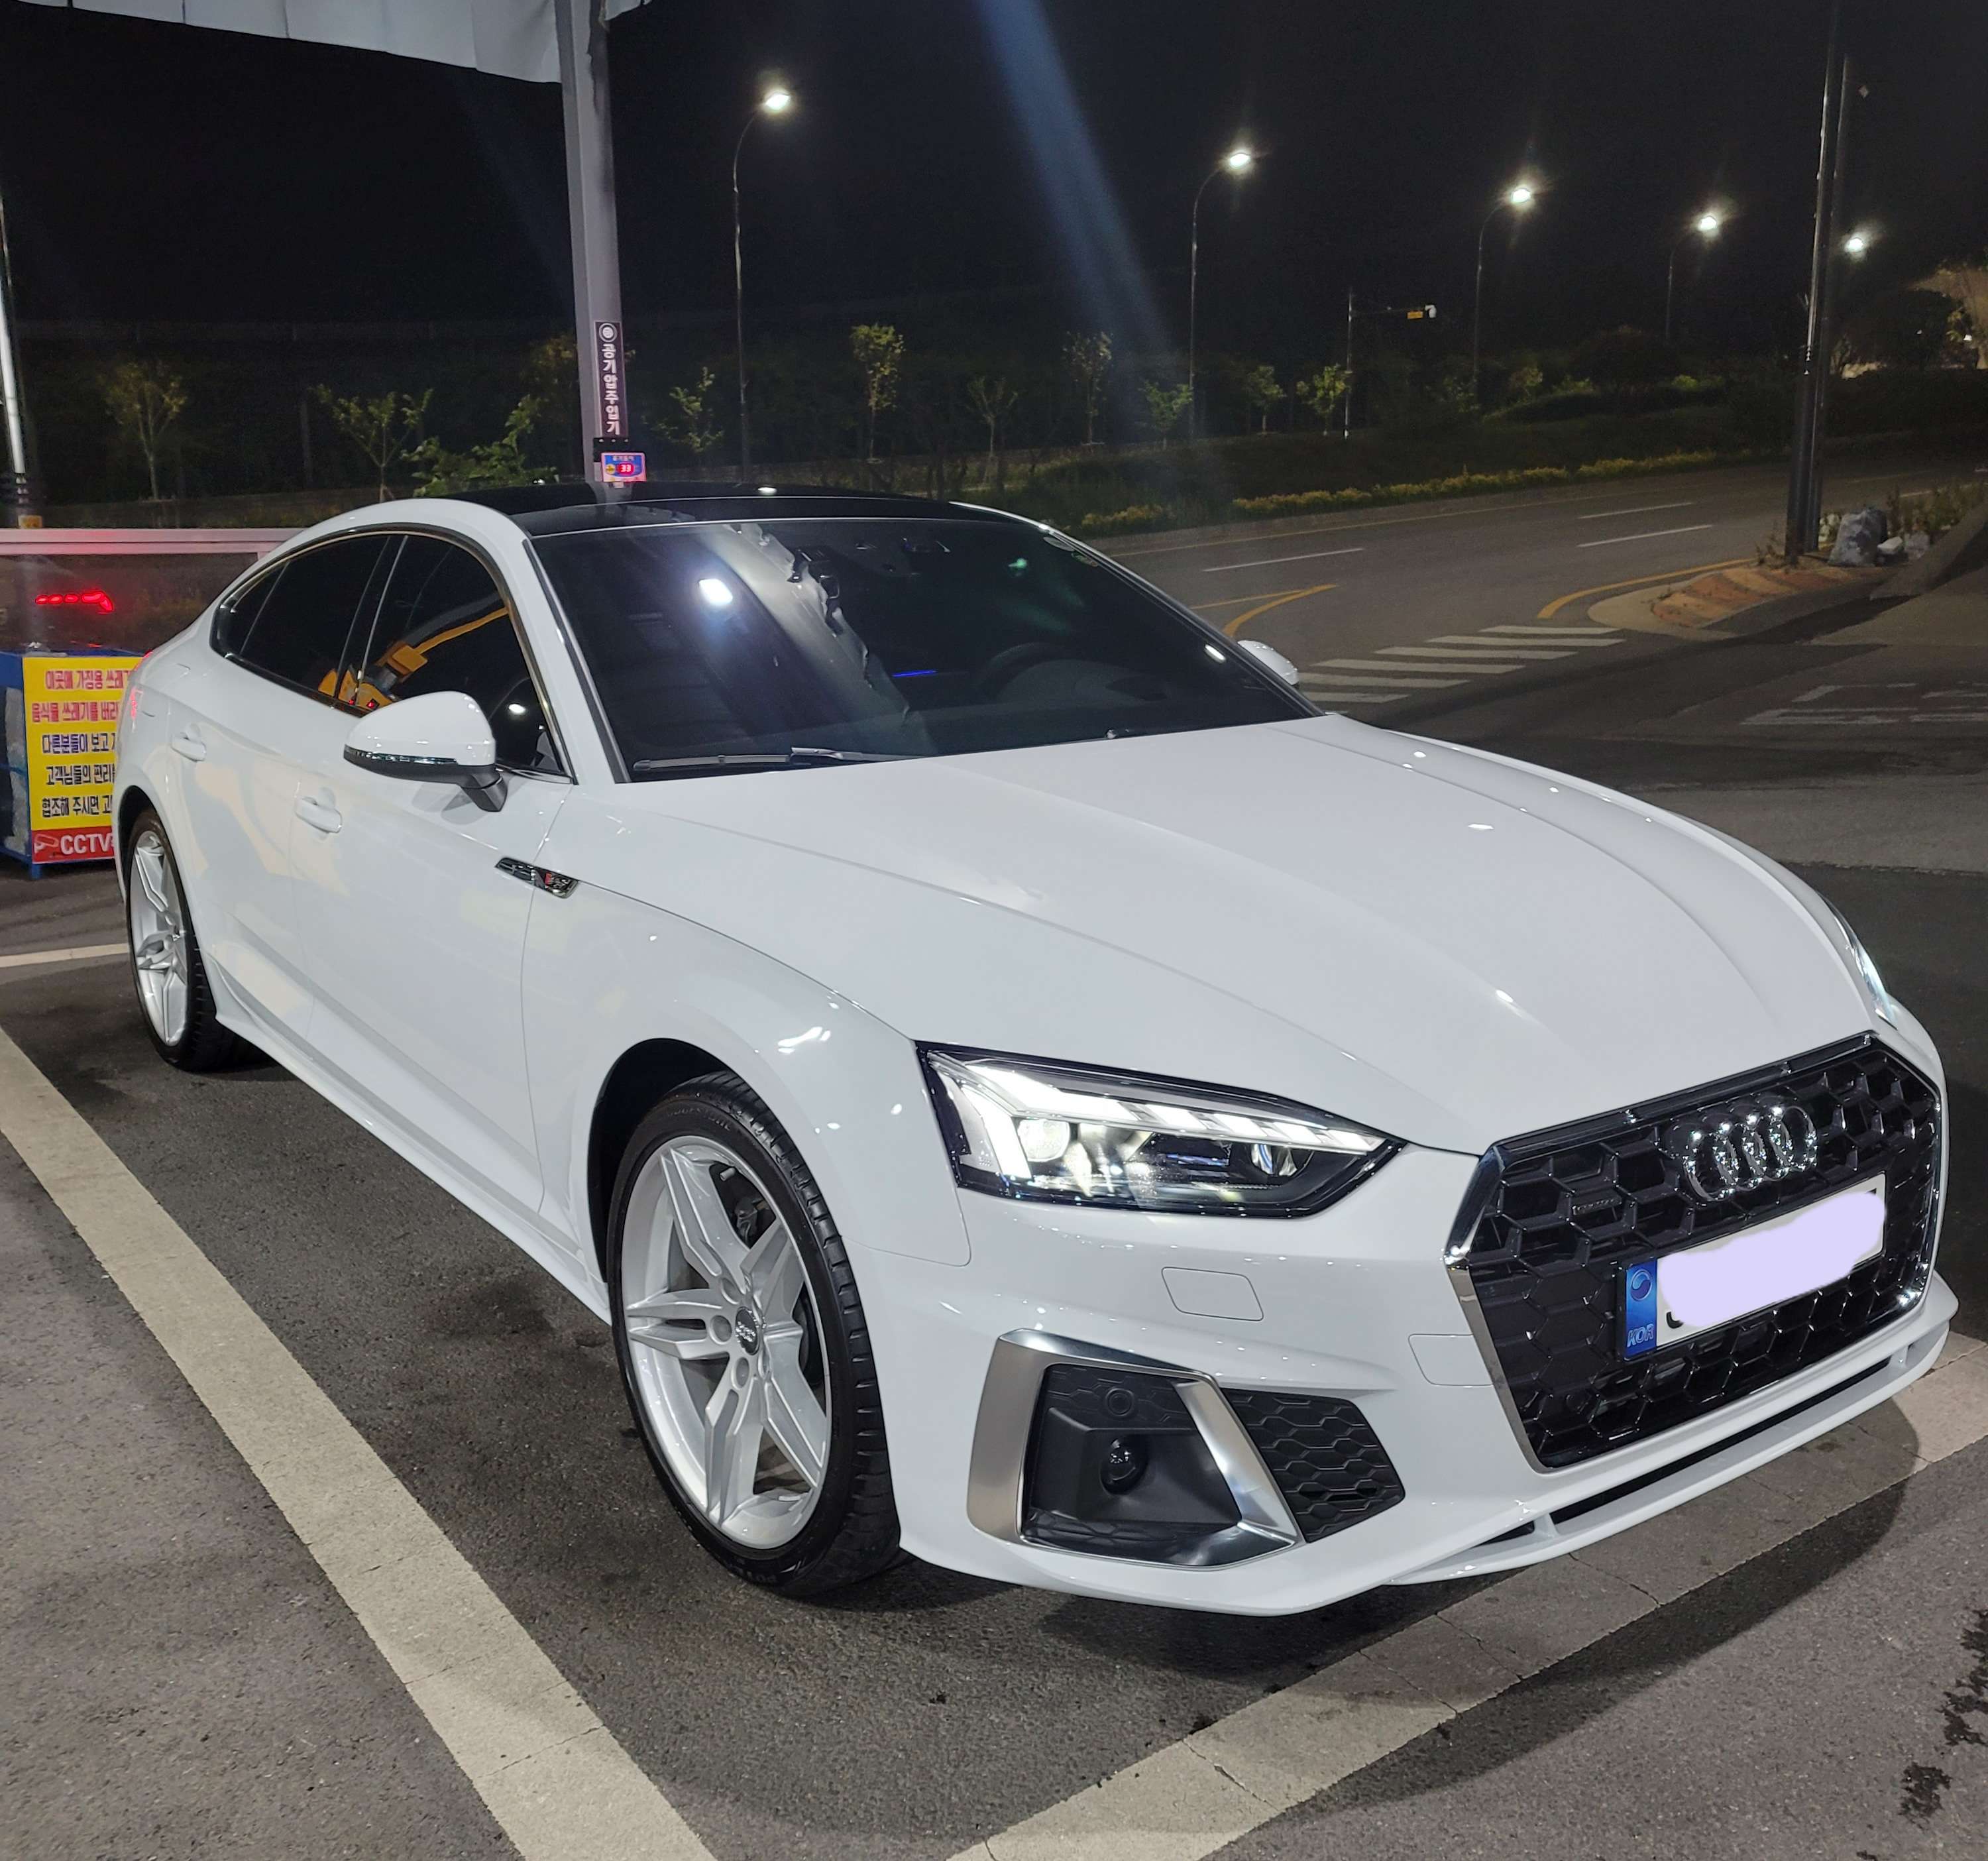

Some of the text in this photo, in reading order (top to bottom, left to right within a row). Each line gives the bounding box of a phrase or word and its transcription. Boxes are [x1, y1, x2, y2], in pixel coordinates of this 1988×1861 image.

[601, 343, 621, 436] 공기압주입기
[45, 670, 74, 690] 이곳에
[76, 670, 103, 690] 가정용
[31, 702, 60, 723] 음식물
[62, 701, 99, 722] 쓰레기를
[42, 734, 88, 754] 다른분들이
[91, 733, 109, 752] 보고
[46, 765, 91, 785] 고객님들의
[42, 797, 70, 818] 협조해
[72, 795, 99, 816] 주시면
[60, 832, 112, 855] CCTV
[1626, 1323, 1655, 1348] KOR
